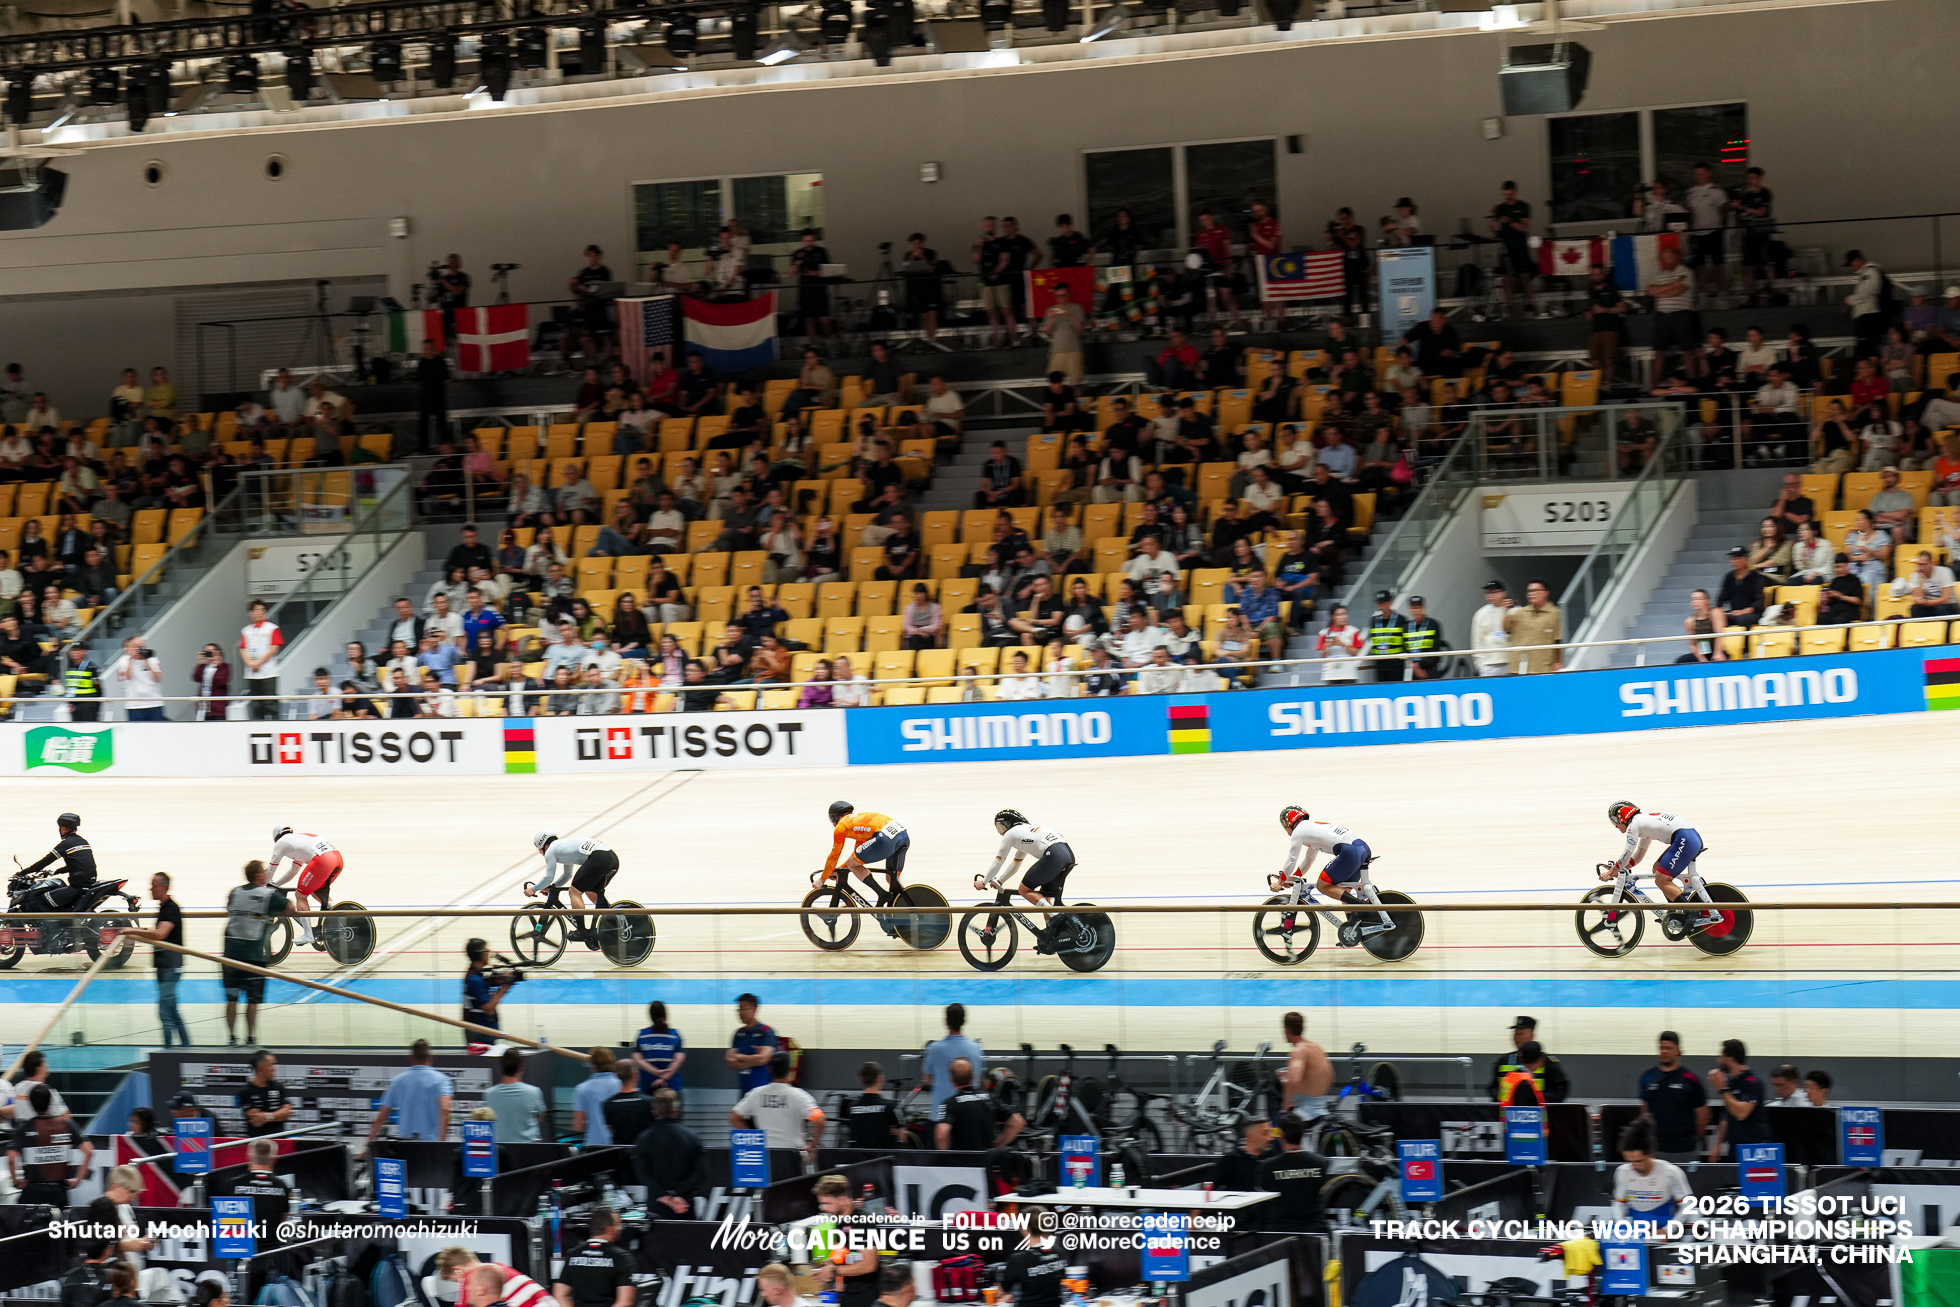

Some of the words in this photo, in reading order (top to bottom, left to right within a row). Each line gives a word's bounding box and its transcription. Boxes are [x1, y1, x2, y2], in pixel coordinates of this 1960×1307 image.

[1543, 501, 1612, 523] S203
[1619, 667, 1858, 717] SHIMANO
[1268, 692, 1494, 737] SHIMANO
[311, 730, 464, 764] TISSOT
[640, 722, 803, 760] TISSOT
[901, 710, 1112, 753] SHIMANO
[40, 736, 98, 764] 怡寶
[1668, 837, 1687, 869] JAPAN
[1062, 1139, 1096, 1153] AUT
[1400, 1143, 1436, 1158] TUR
[1741, 1147, 1779, 1162] LAT
